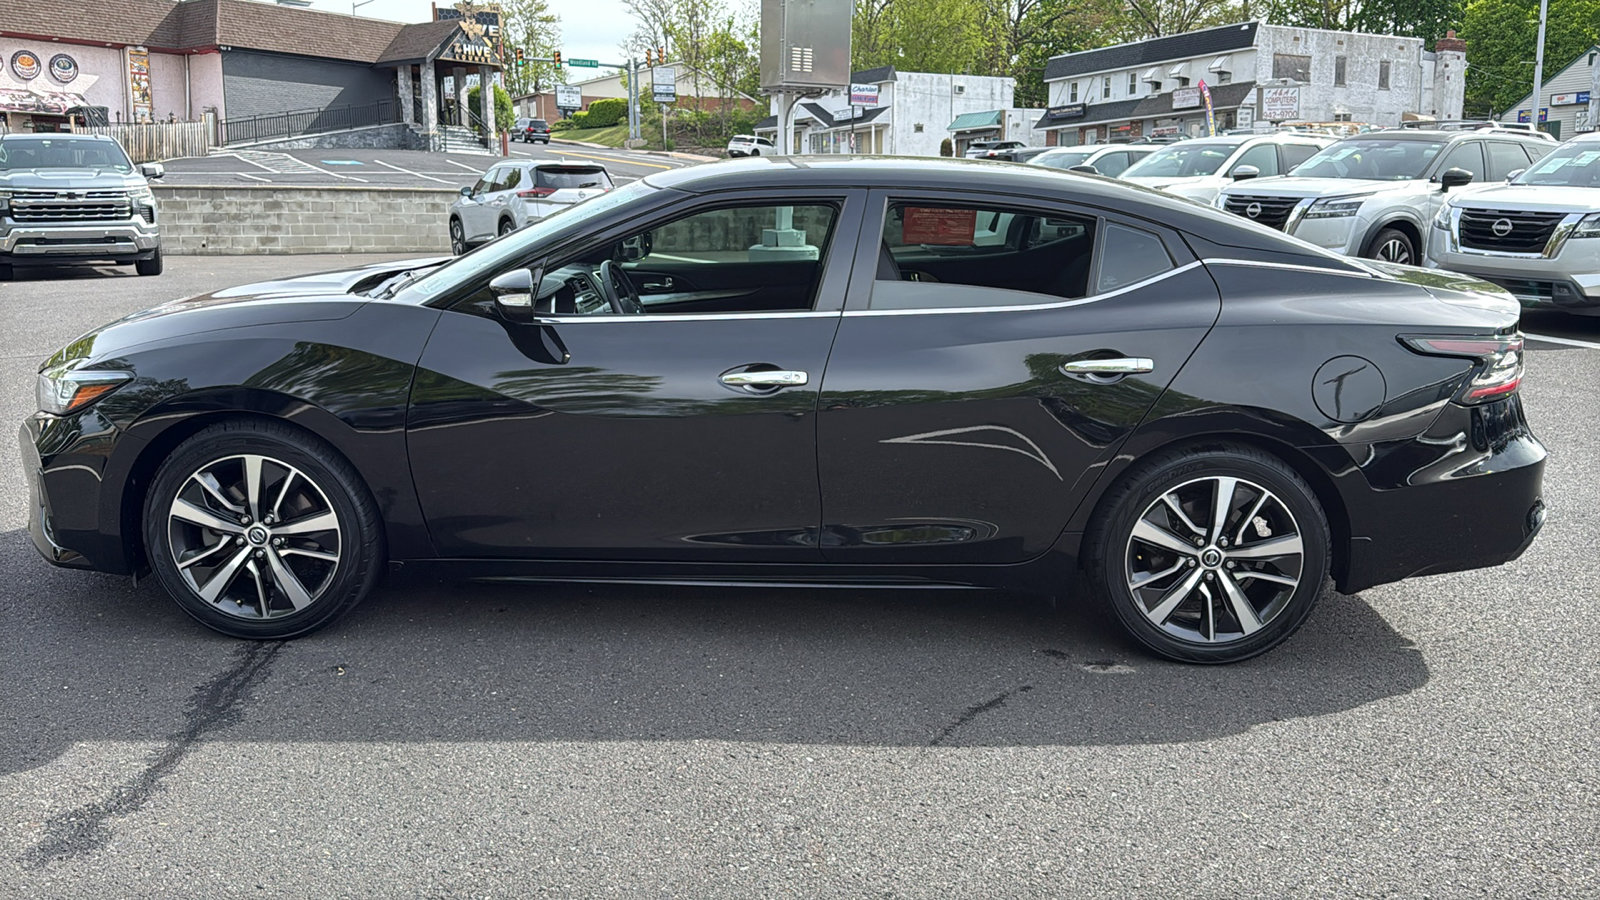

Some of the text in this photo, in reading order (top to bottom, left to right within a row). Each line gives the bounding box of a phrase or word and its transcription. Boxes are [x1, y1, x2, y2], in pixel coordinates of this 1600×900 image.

[463, 44, 492, 58] HIVE
[1265, 96, 1297, 104] COMPUTERS
[1263, 111, 1298, 119] 942-9700
